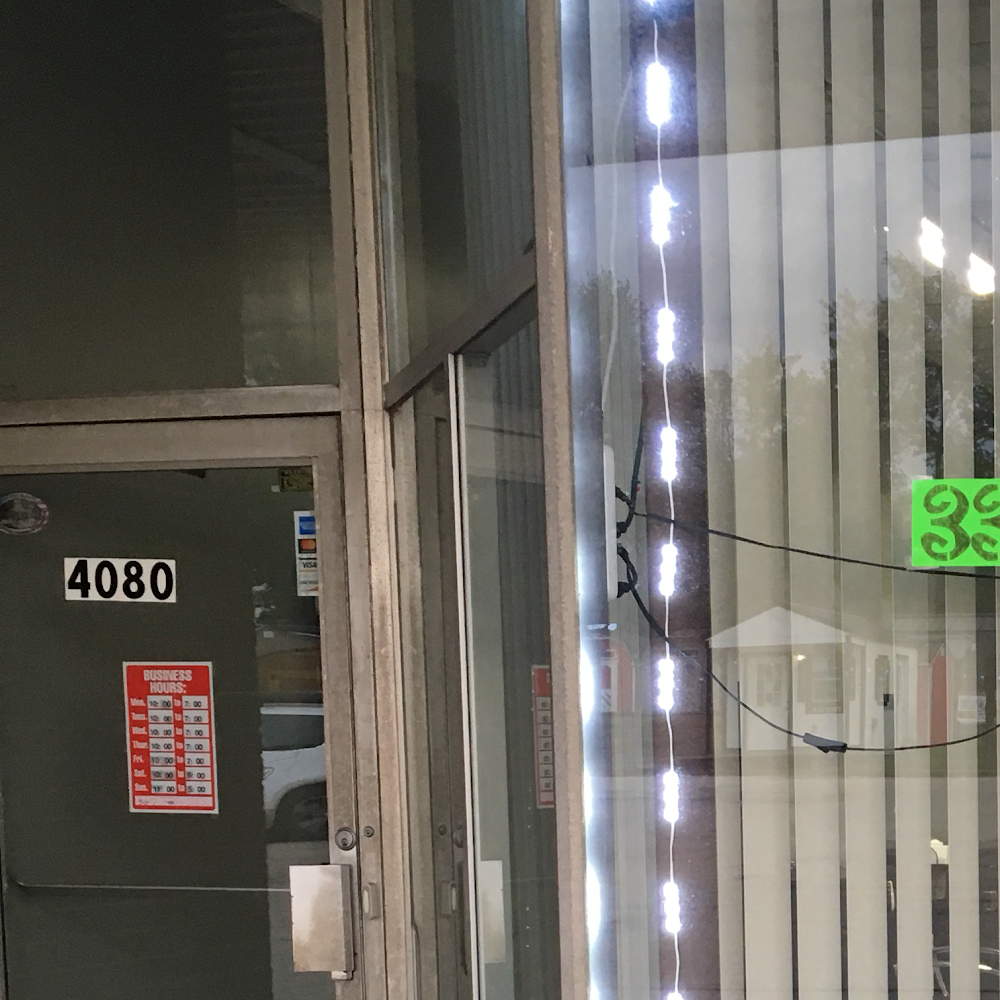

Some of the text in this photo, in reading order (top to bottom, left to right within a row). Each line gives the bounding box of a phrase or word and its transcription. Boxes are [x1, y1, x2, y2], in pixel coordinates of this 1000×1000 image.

[66, 558, 174, 600] 4080
[143, 669, 193, 681] BUSINESS
[150, 682, 187, 694] HOURS:
